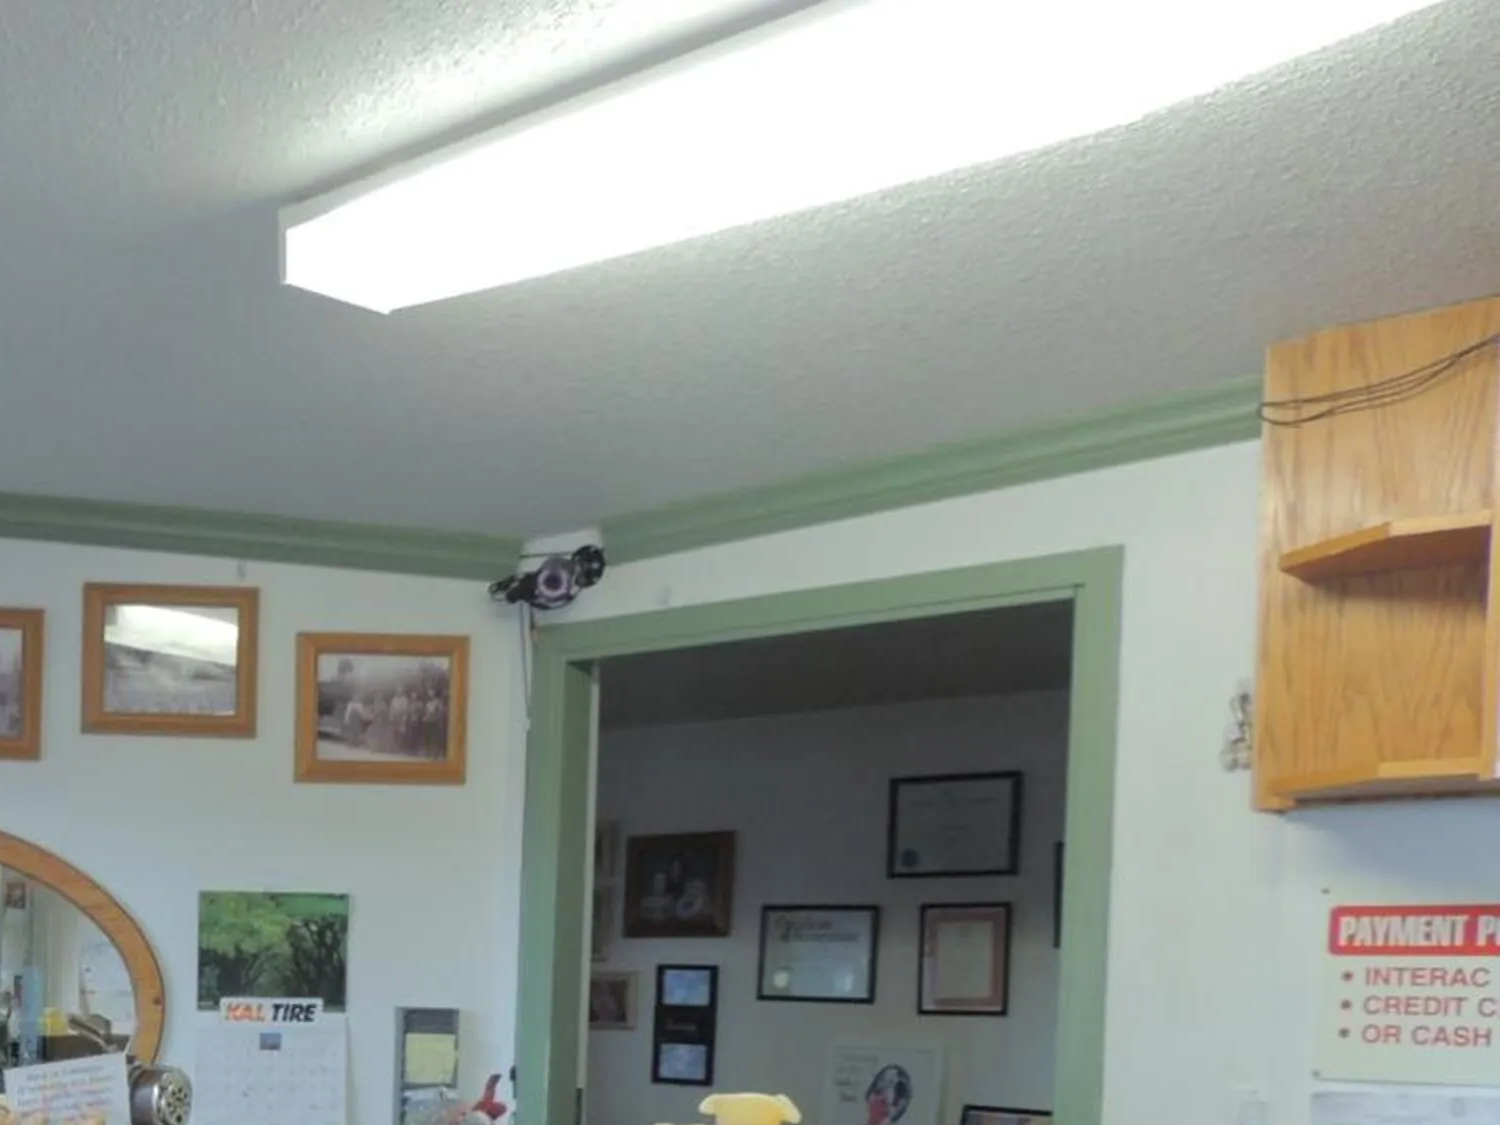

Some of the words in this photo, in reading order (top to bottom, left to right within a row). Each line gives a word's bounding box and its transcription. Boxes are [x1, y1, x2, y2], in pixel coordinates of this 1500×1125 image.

[1338, 914, 1469, 947] PAYMENT
[1364, 966, 1491, 988] INTERAC
[224, 1003, 265, 1022] KAL
[272, 1003, 318, 1023] TIRE
[1363, 995, 1469, 1017] CREDIT
[1477, 997, 1500, 1018] C
[1361, 1024, 1402, 1044] OR
[1411, 1025, 1492, 1048] CASH
